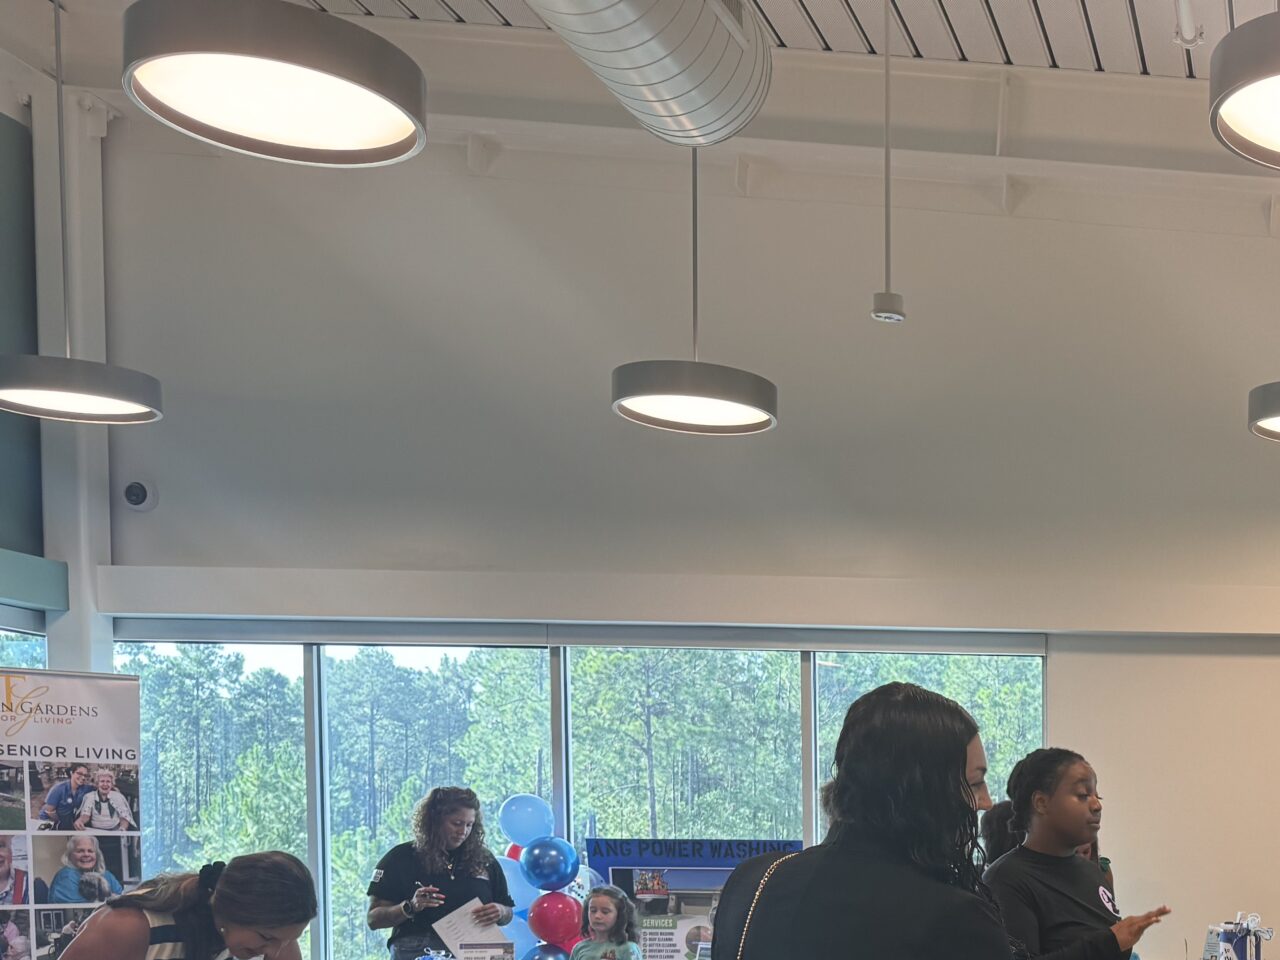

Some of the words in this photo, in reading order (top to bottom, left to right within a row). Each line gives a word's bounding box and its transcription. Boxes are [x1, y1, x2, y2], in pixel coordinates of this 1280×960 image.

[20, 701, 99, 717] GARDENS
[33, 716, 73, 724] LIVING
[75, 747, 137, 760] LIVING
[592, 839, 636, 859] ANG
[638, 840, 707, 859] POWER
[642, 919, 673, 928] SERVICES
